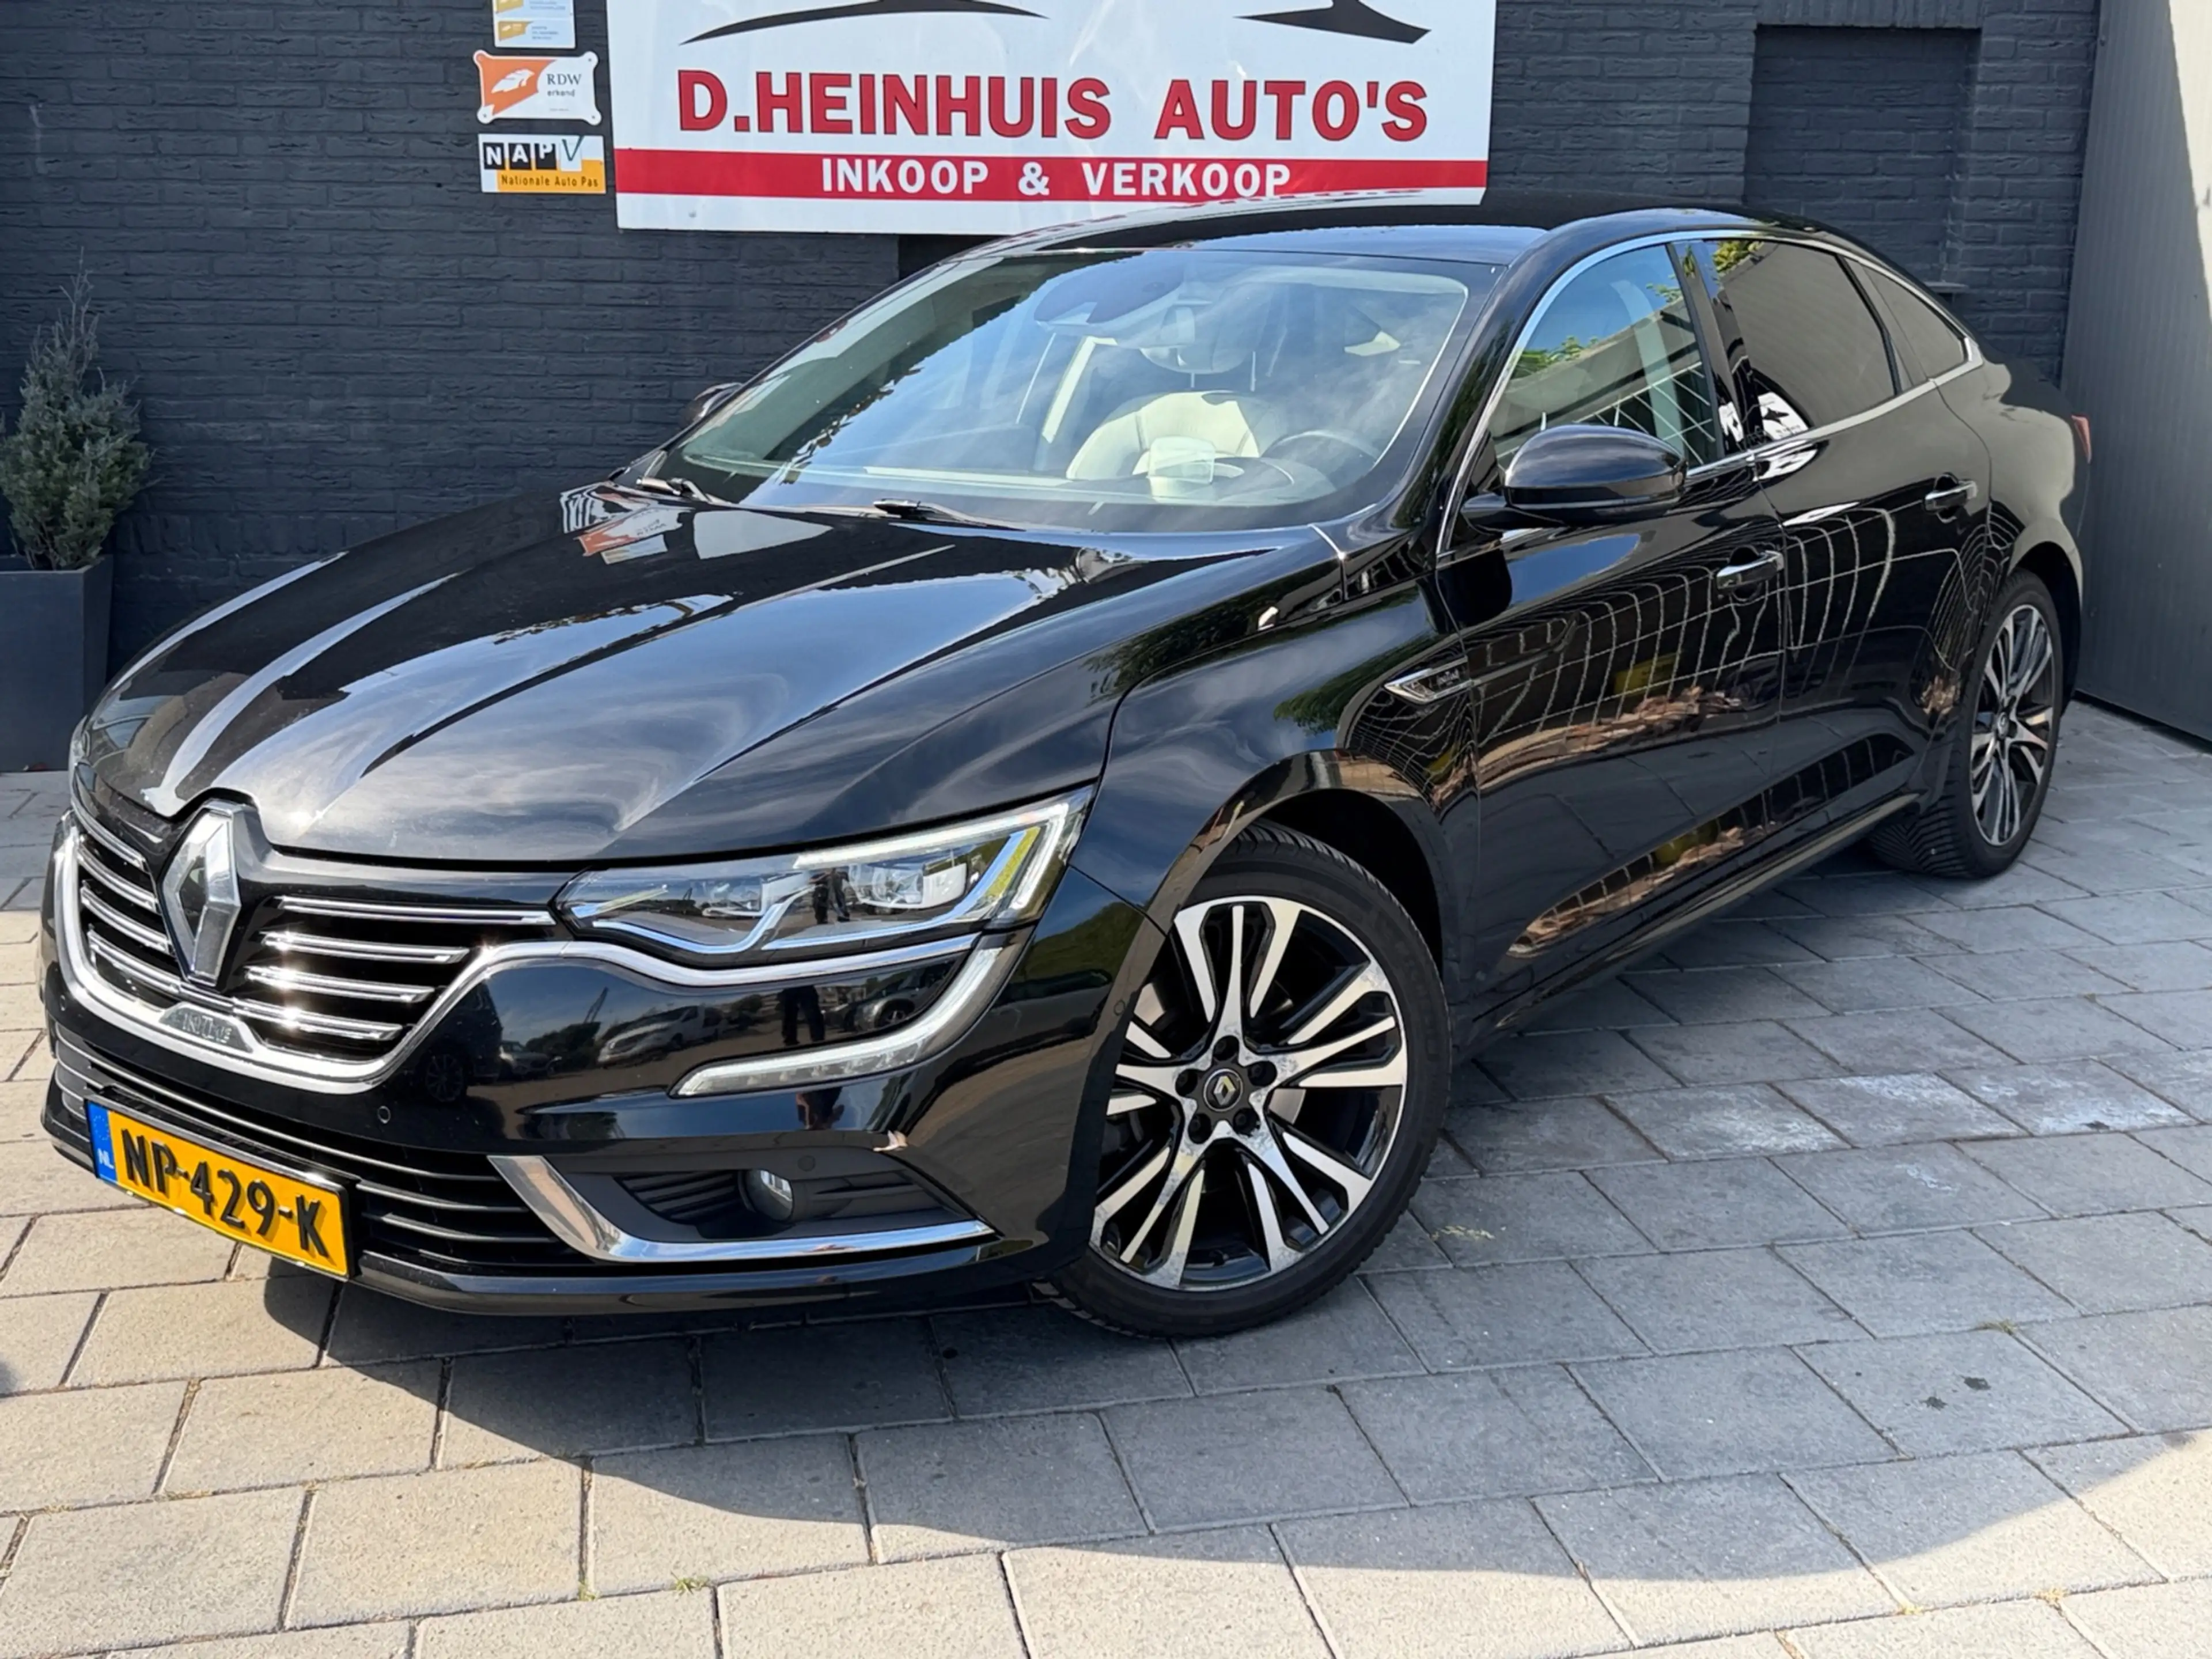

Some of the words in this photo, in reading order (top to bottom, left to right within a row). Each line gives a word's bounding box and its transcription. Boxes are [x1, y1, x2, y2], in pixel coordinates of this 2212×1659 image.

[546, 73, 582, 85] RDW
[677, 69, 1112, 139] D.HEINHUIS
[1154, 79, 1427, 142] AUTO'S
[501, 174, 550, 186] Nationale
[555, 176, 577, 187] Auto
[581, 176, 599, 187] Pas
[821, 158, 989, 194] INKOOP
[1018, 161, 1050, 196] &
[1081, 162, 1291, 197] VERKOOP
[98, 1148, 114, 1169] NL
[120, 1128, 329, 1258] NP-429-K
